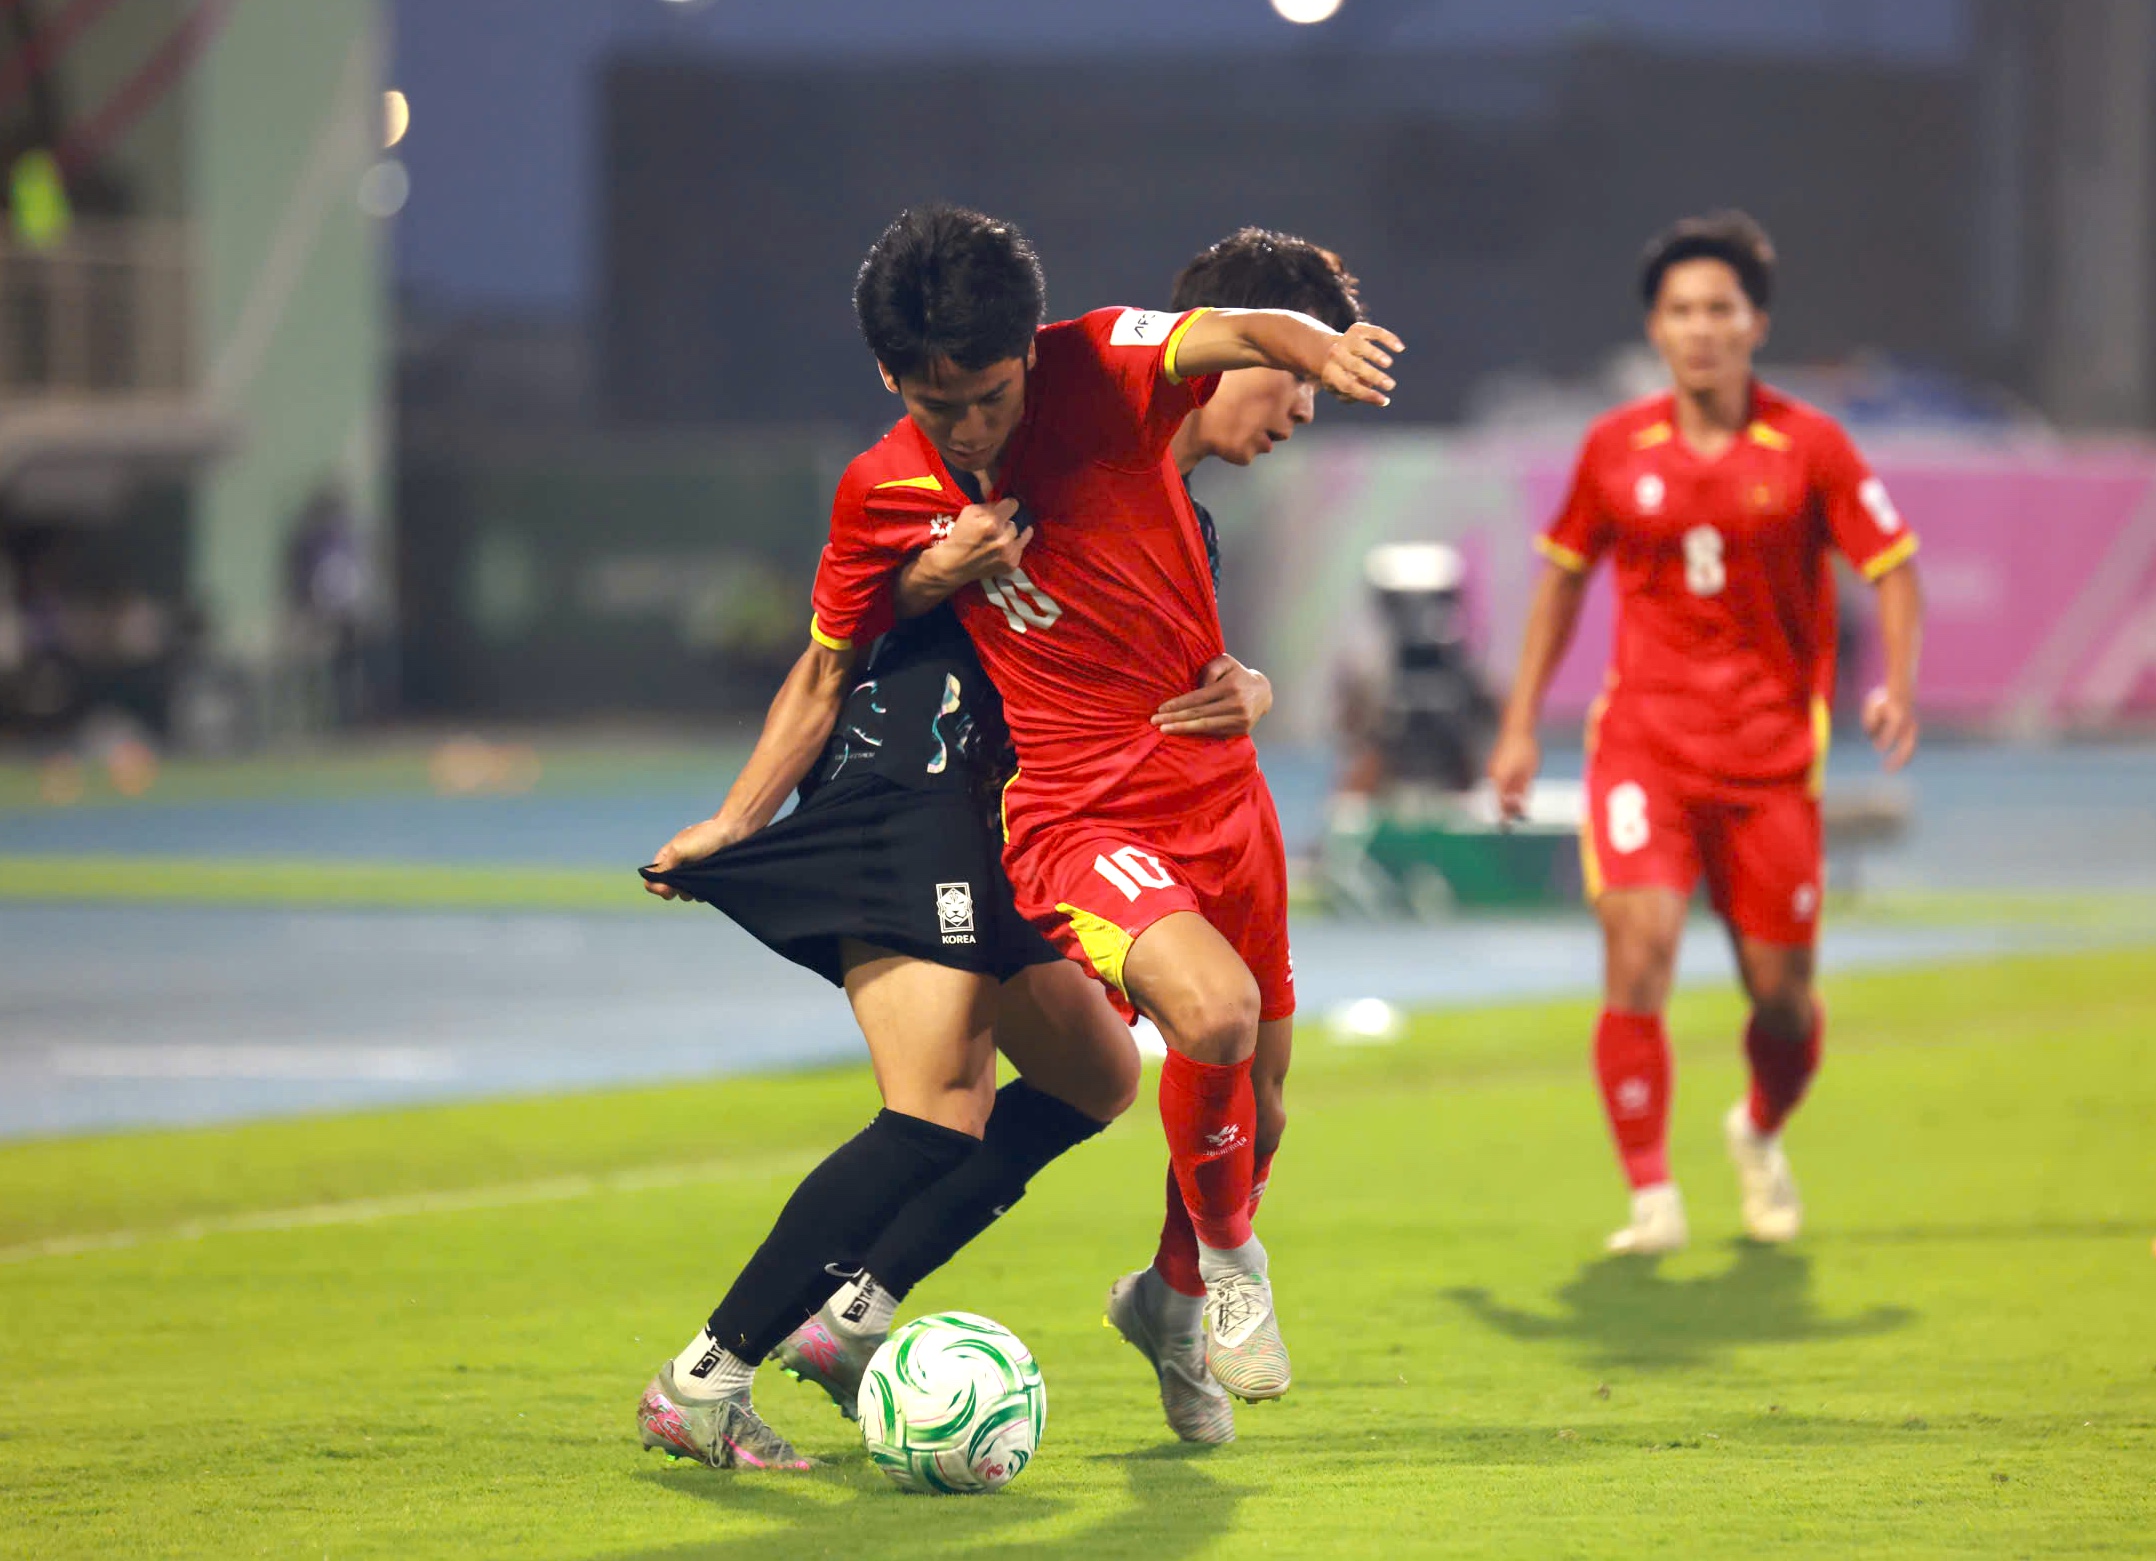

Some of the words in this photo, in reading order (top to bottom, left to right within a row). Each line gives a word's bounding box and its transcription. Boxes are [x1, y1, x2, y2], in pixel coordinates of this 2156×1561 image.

[1684, 524, 1726, 596] 8
[981, 567, 1063, 634] 10
[1607, 781, 1651, 853] 8
[1094, 846, 1175, 902] 10
[941, 934, 977, 944] KOREA
